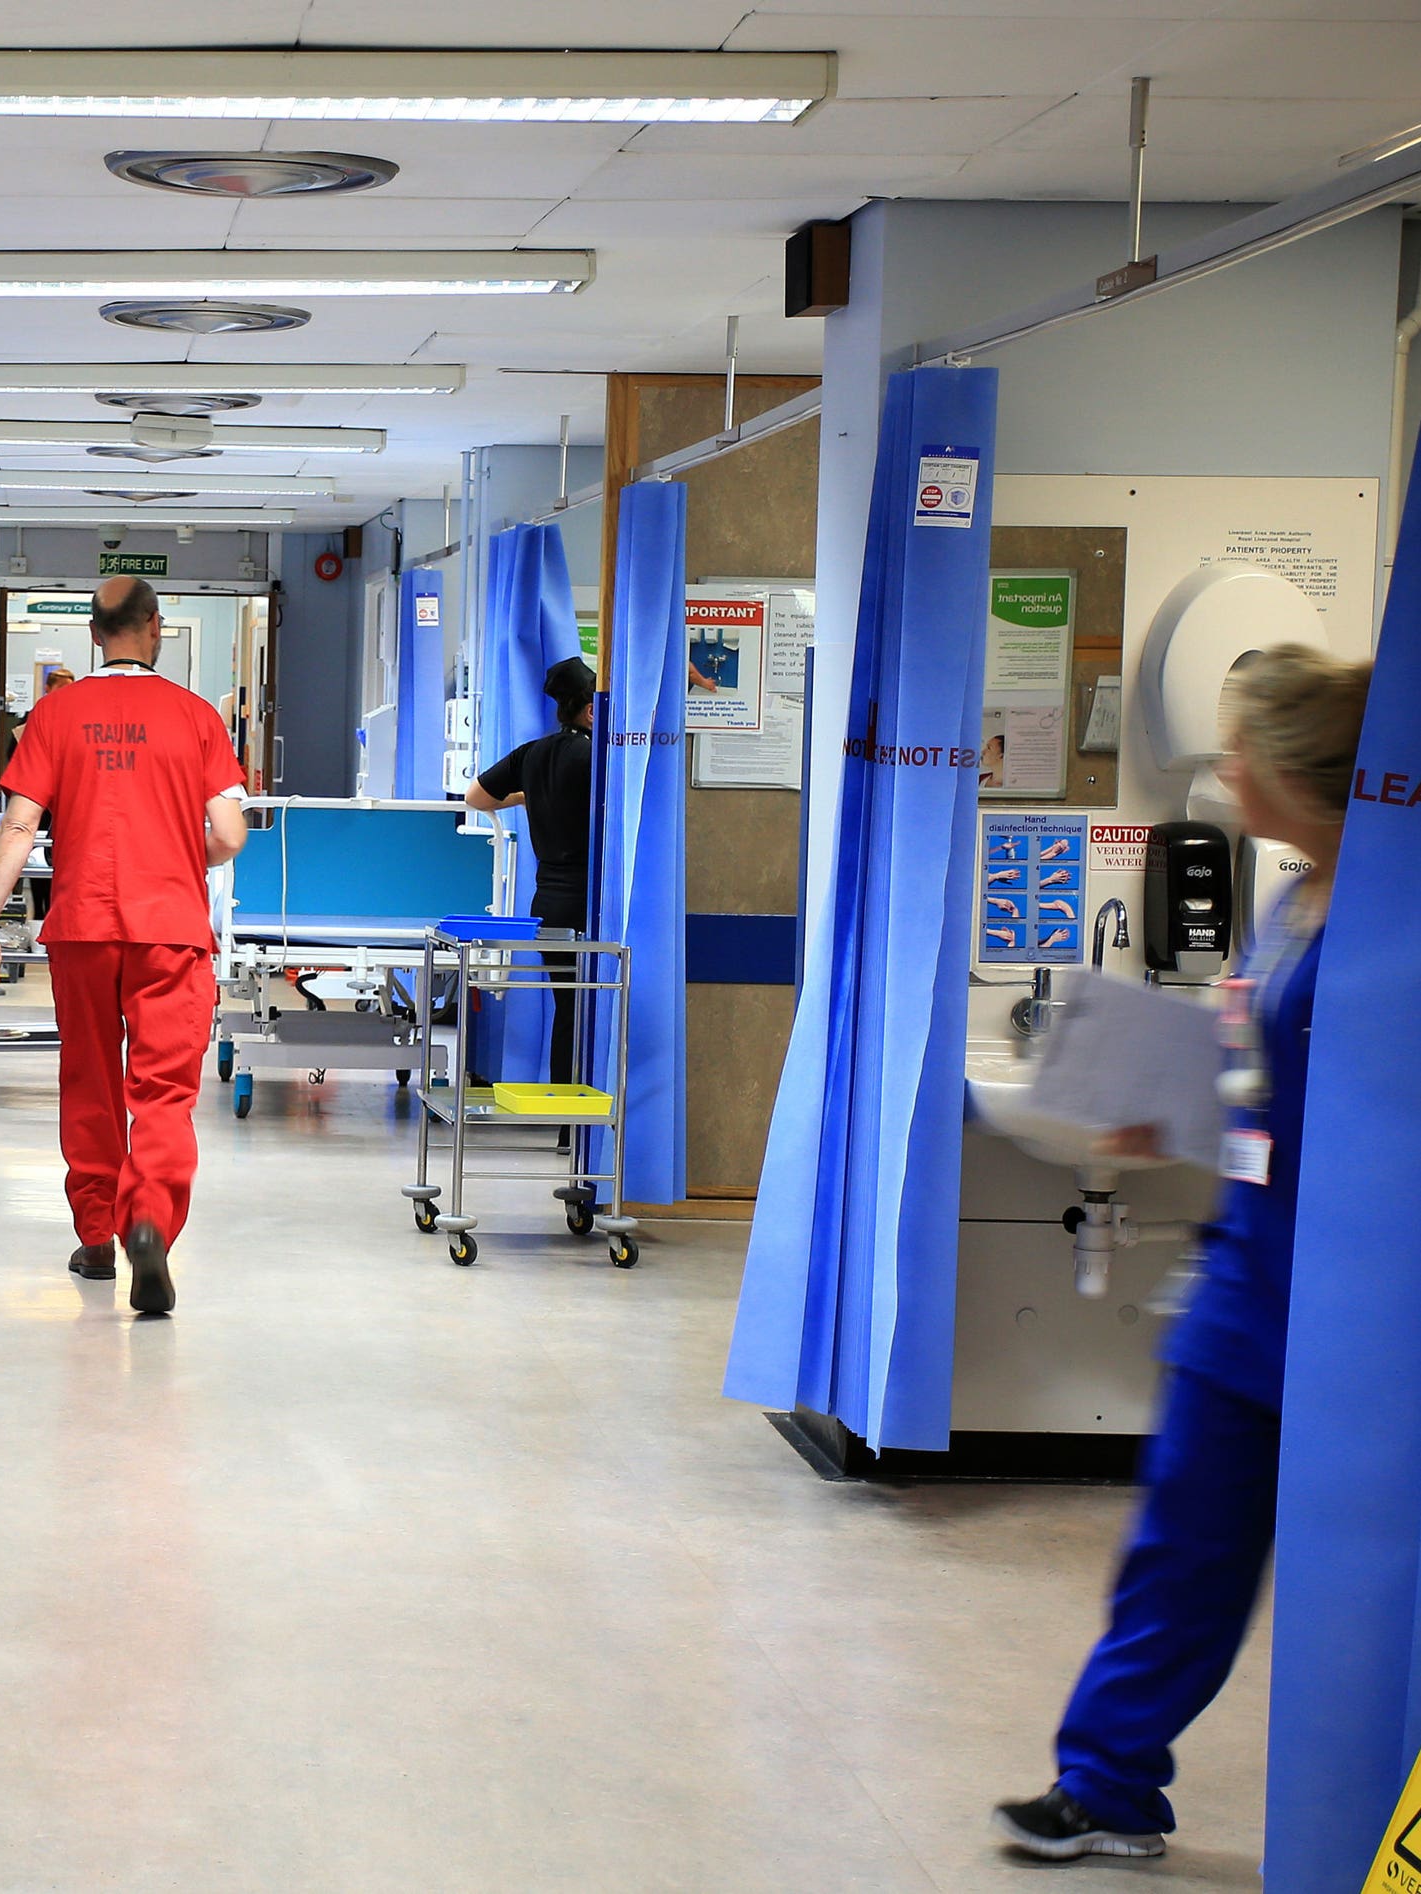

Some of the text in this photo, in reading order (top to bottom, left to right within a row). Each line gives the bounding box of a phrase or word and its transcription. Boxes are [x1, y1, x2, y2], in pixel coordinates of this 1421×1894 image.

[1270, 547, 1312, 555] PROPERTY
[121, 559, 165, 571] FIRE EXIT
[82, 723, 147, 745] TRAUMA
[95, 749, 136, 771] TEAM
[899, 747, 944, 767] NOT
[1024, 815, 1047, 824] Hand
[989, 824, 1083, 834] disinfection technique
[1096, 847, 1126, 855] VERY
[1105, 858, 1142, 867] WATER
[1188, 928, 1216, 937] HAND
